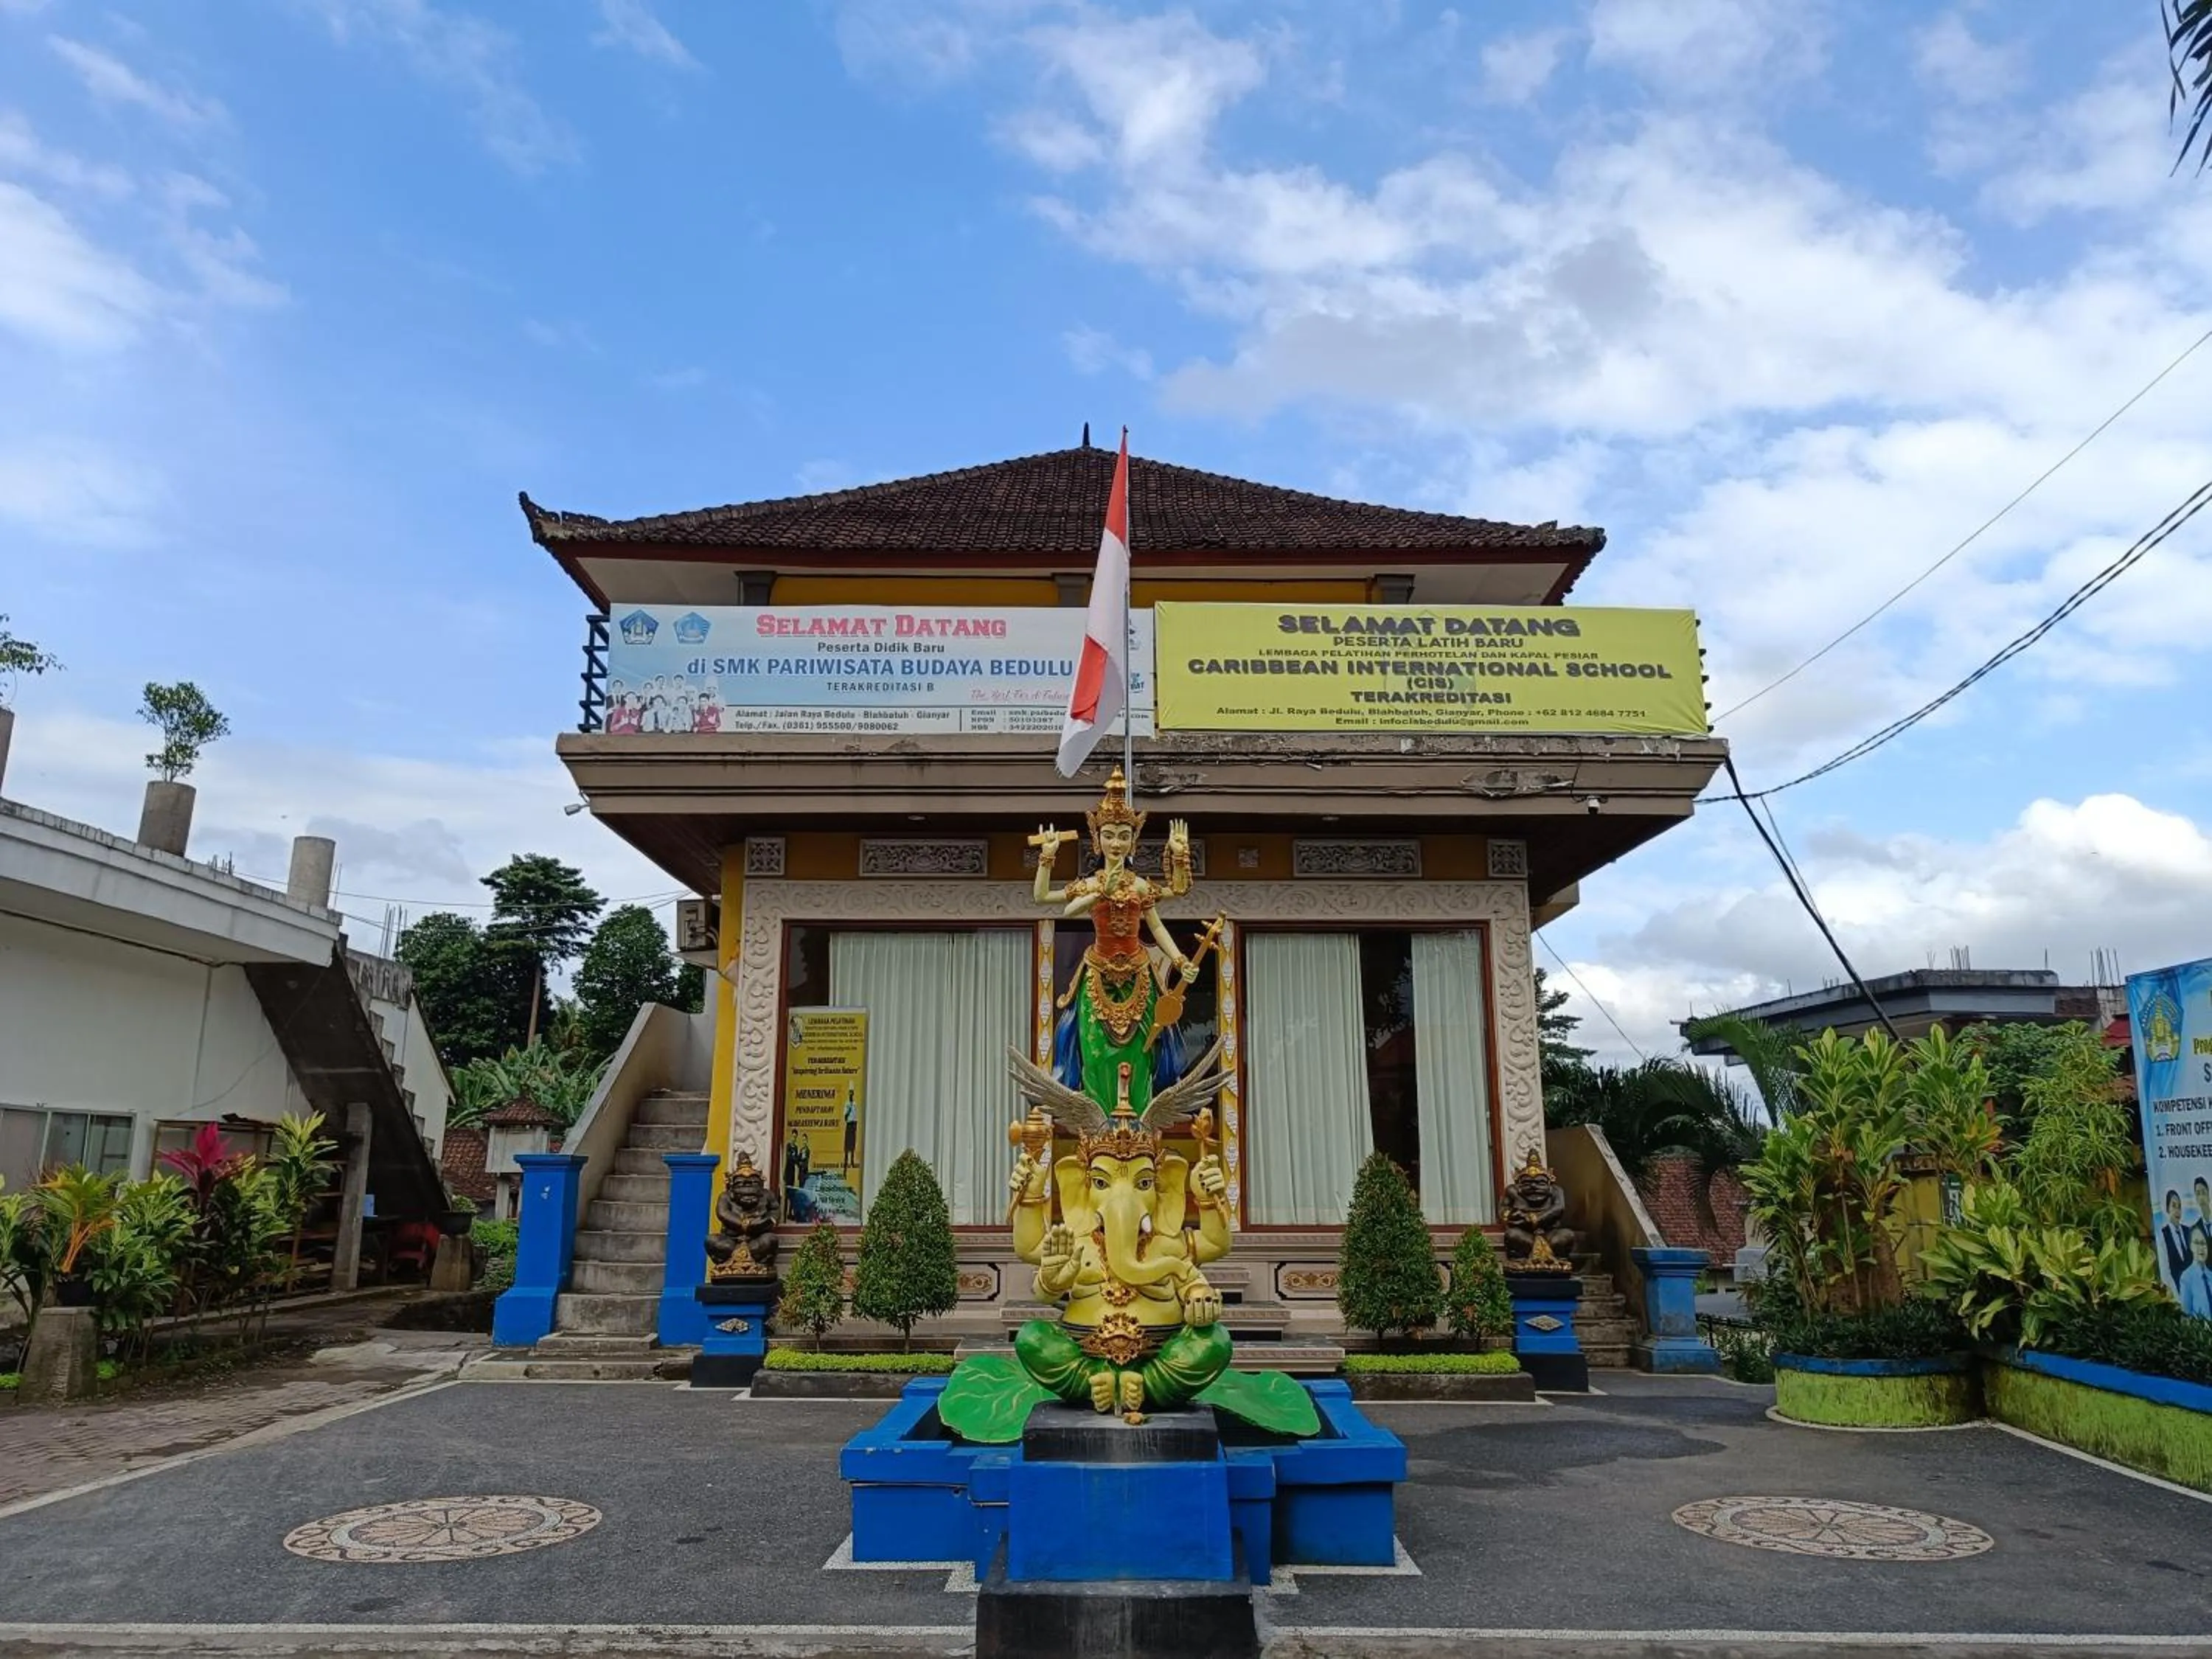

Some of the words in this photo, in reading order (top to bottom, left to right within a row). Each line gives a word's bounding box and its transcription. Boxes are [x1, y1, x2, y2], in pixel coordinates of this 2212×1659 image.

[756, 613, 888, 637] SELAMAT
[894, 614, 1006, 639] DATANG
[1277, 614, 1436, 635] SELAMAT
[1444, 617, 1581, 637] DATANG
[817, 642, 870, 653] Peserta
[874, 642, 909, 653] Didik
[913, 643, 945, 653] Baru
[1333, 636, 1411, 647] PESERTA
[1418, 637, 1470, 647] LATIH
[1474, 637, 1524, 648] BARU
[1259, 649, 1318, 657] LEMBAGA
[1321, 650, 1391, 658] PELATIHAN
[1394, 650, 1477, 658] PERHOTELAN
[1510, 651, 1550, 659] KAPAL
[1554, 652, 1599, 660] PESIAR
[686, 658, 706, 675] di
[712, 658, 760, 675] SMK
[767, 658, 894, 675] PARIWISATA
[901, 659, 983, 675] BUDAYA
[990, 660, 1073, 676] BEDULU
[1188, 658, 1339, 675] CARIBBEAN
[1346, 659, 1559, 678] INTERNATIONAL
[1565, 663, 1673, 679] SCHOOL
[827, 682, 922, 692] TERAKREDITASI
[927, 683, 934, 692] B
[1407, 676, 1454, 690] (CIS)
[1350, 691, 1512, 704] TERAKREDITASI
[801, 710, 822, 720] Raya
[824, 710, 855, 718] Bedulu
[863, 710, 909, 719] Blahbatuh
[917, 711, 950, 720] Gianyar
[1287, 708, 1316, 716] Raya
[1320, 708, 1364, 716] Bedulu,
[1368, 709, 1432, 717] Blahbatuh,
[1436, 709, 1484, 717] Gianyar,
[782, 721, 814, 730] (0361)
[2153, 1096, 2207, 1113] KOMPETENSI
[2166, 1121, 2193, 1136] FRONT
